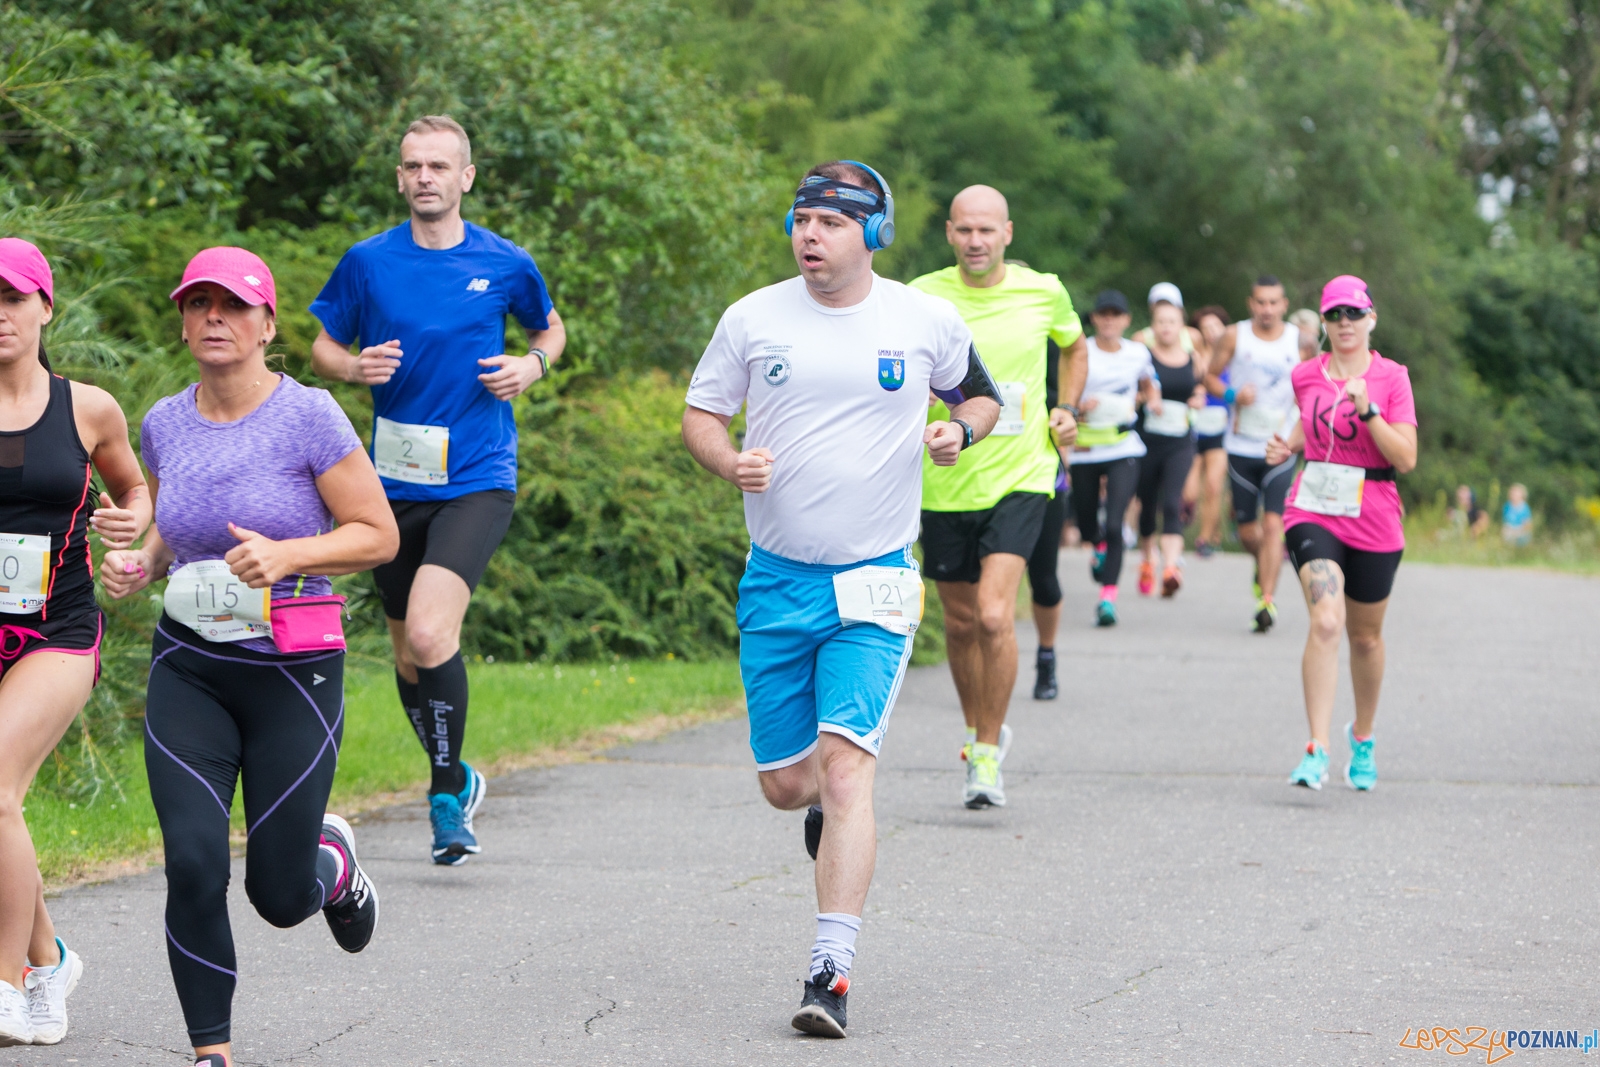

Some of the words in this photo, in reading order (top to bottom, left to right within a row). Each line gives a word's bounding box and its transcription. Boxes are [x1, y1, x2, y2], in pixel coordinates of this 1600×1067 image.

[402, 440, 413, 459] 2
[1320, 475, 1339, 494] 75
[195, 583, 239, 609] 115
[866, 583, 903, 606] 121
